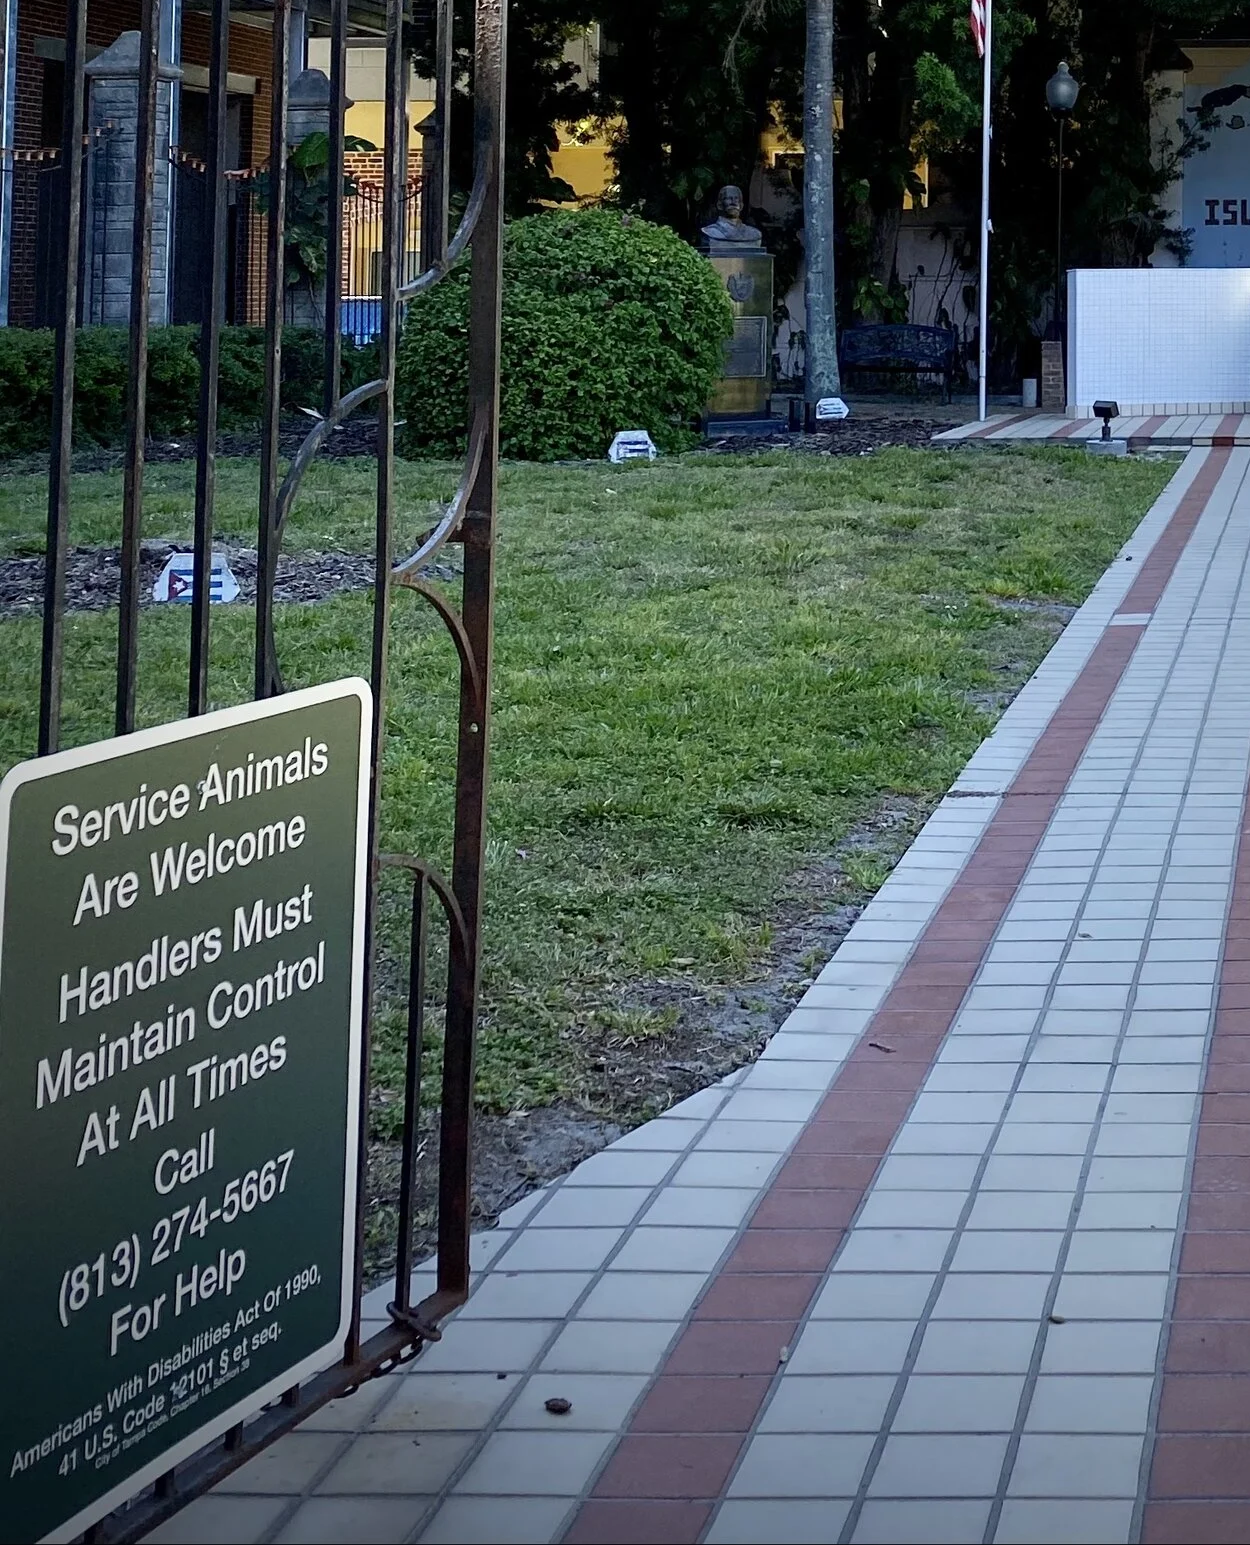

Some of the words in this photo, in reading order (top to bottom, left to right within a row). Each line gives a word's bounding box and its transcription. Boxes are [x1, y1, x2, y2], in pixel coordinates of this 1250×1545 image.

[51, 783, 190, 856] Service
[198, 736, 329, 811] Animals
[72, 872, 139, 926] Are
[150, 815, 306, 896] Welcome
[58, 926, 222, 1024] Handlers
[232, 883, 313, 952] Must
[36, 1003, 195, 1109] Maintain
[206, 940, 325, 1030] Control
[76, 1105, 120, 1167] At
[129, 1074, 176, 1141] All
[186, 1035, 287, 1109] Times
[154, 1127, 215, 1195] Call
[58, 1233, 141, 1328] (813)
[151, 1148, 295, 1267] 274-5667
[110, 1292, 167, 1357] For
[174, 1247, 246, 1317] Help
[10, 1403, 103, 1479] Americans
[106, 1374, 143, 1413] With
[147, 1321, 231, 1388] Disabilities
[234, 1299, 260, 1333] Act
[263, 1285, 282, 1312] Of
[284, 1264, 321, 1300] 1990,
[58, 1448, 77, 1476] 41
[84, 1423, 118, 1461] U.S.
[122, 1394, 165, 1435] Code
[169, 1357, 214, 1399] 12101
[219, 1348, 229, 1376] §
[232, 1336, 248, 1362] et
[251, 1321, 282, 1351] seq.
